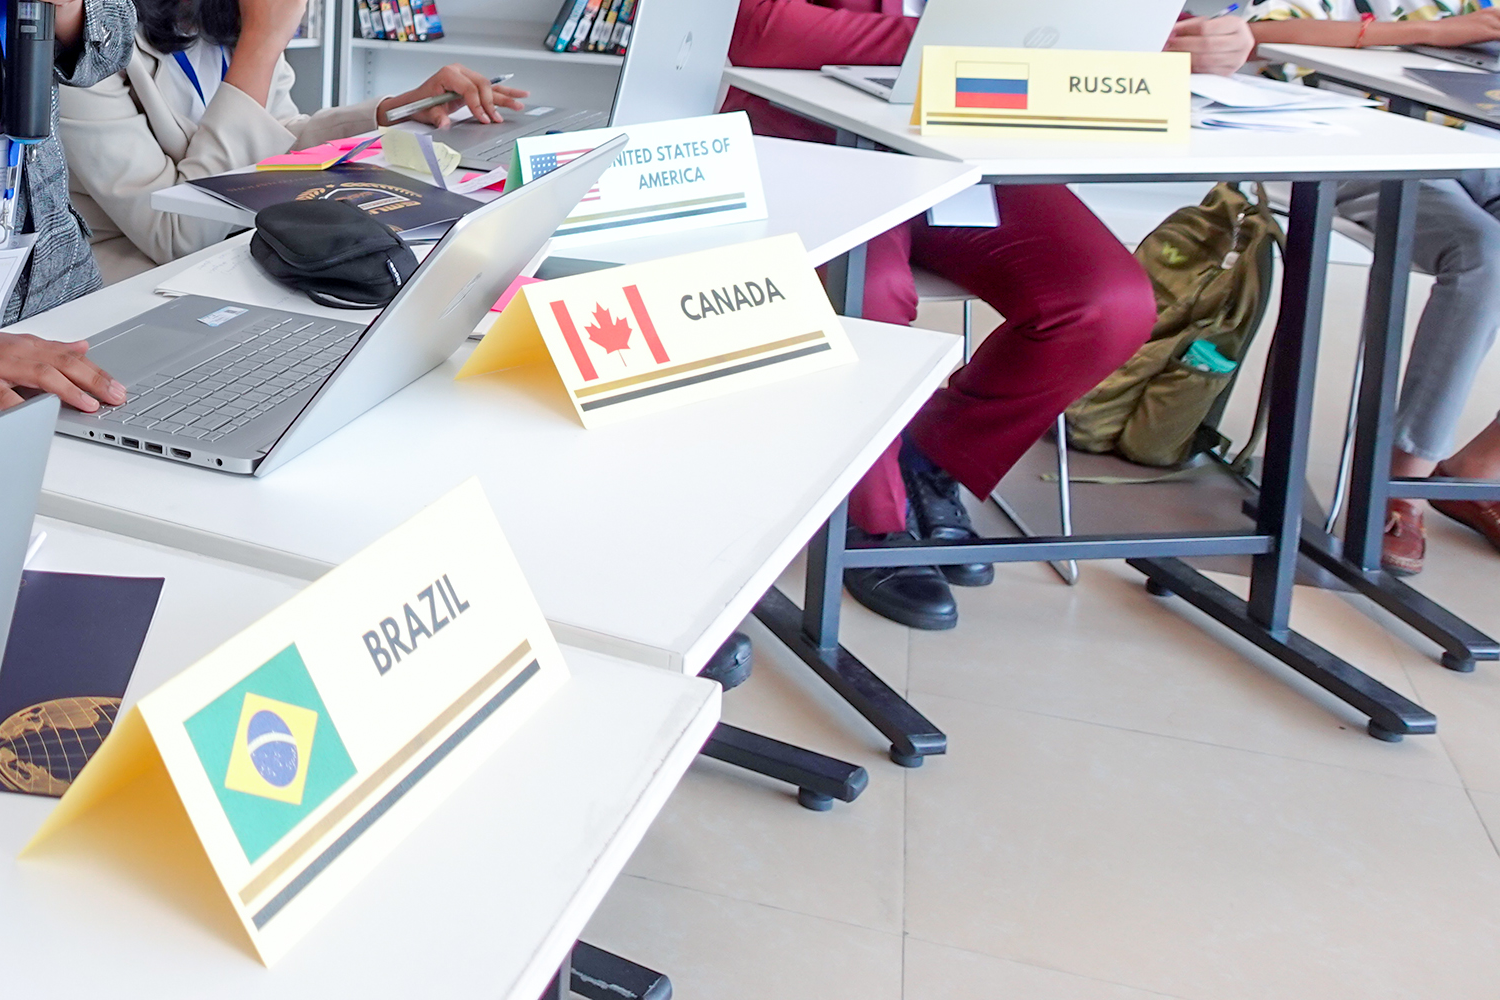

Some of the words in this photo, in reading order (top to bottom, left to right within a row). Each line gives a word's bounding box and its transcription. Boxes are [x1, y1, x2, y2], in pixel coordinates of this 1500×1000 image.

[1070, 76, 1151, 95] RUSSIA
[608, 148, 652, 168] NITED
[657, 141, 709, 161] STATES
[712, 138, 731, 153] OF
[639, 167, 705, 190] AMERICA
[680, 277, 785, 321] CANADA
[362, 574, 470, 677] BRAZIL
